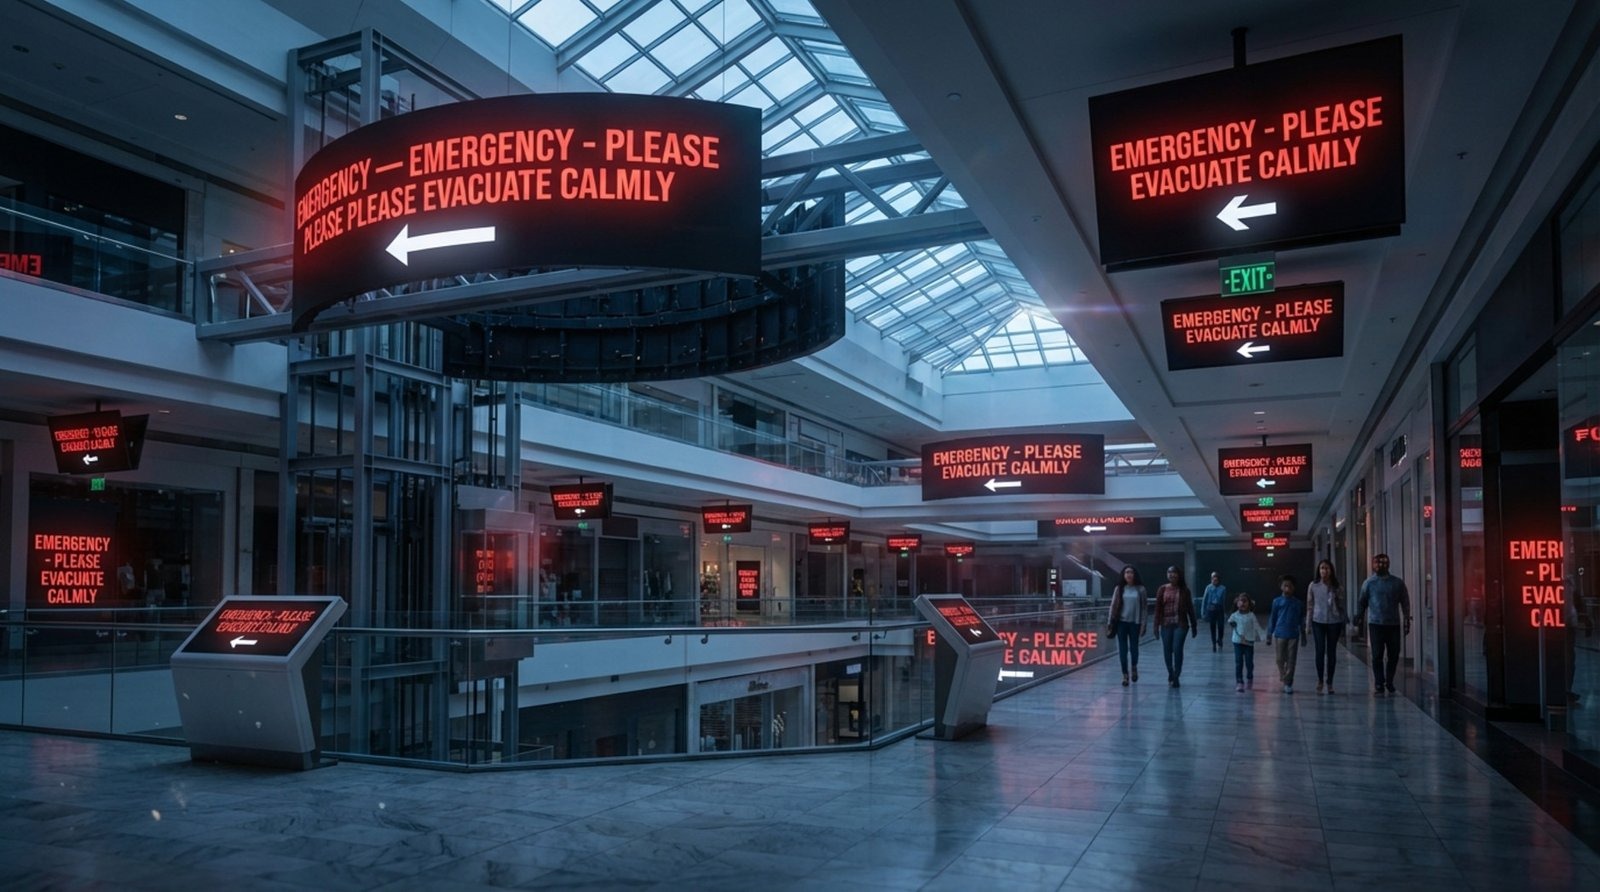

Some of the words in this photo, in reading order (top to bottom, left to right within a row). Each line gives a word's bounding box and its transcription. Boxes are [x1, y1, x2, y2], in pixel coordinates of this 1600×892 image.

[1110, 119, 1256, 172] EMERGENCY
[1282, 96, 1382, 142] PLEASE
[409, 128, 574, 178] EMERGENCY
[605, 128, 720, 169] PLEASE
[1130, 154, 1252, 200] EVACUATE
[1258, 135, 1361, 179] CALMLY
[347, 188, 417, 231] PLEASE
[423, 168, 553, 212] EVACUATE
[560, 167, 676, 202] CALMLY
[1230, 266, 1267, 293] EXIT
[1275, 298, 1333, 318] PLEASE
[1186, 324, 1257, 344] EVACUATE
[1261, 317, 1321, 337] CALMLY
[1024, 444, 1083, 459] PLEASE
[54, 552, 101, 569] PLEASE
[41, 570, 104, 586] EVACUATE
[48, 588, 98, 604] CALMLY
[1033, 631, 1098, 648] PLEASE
